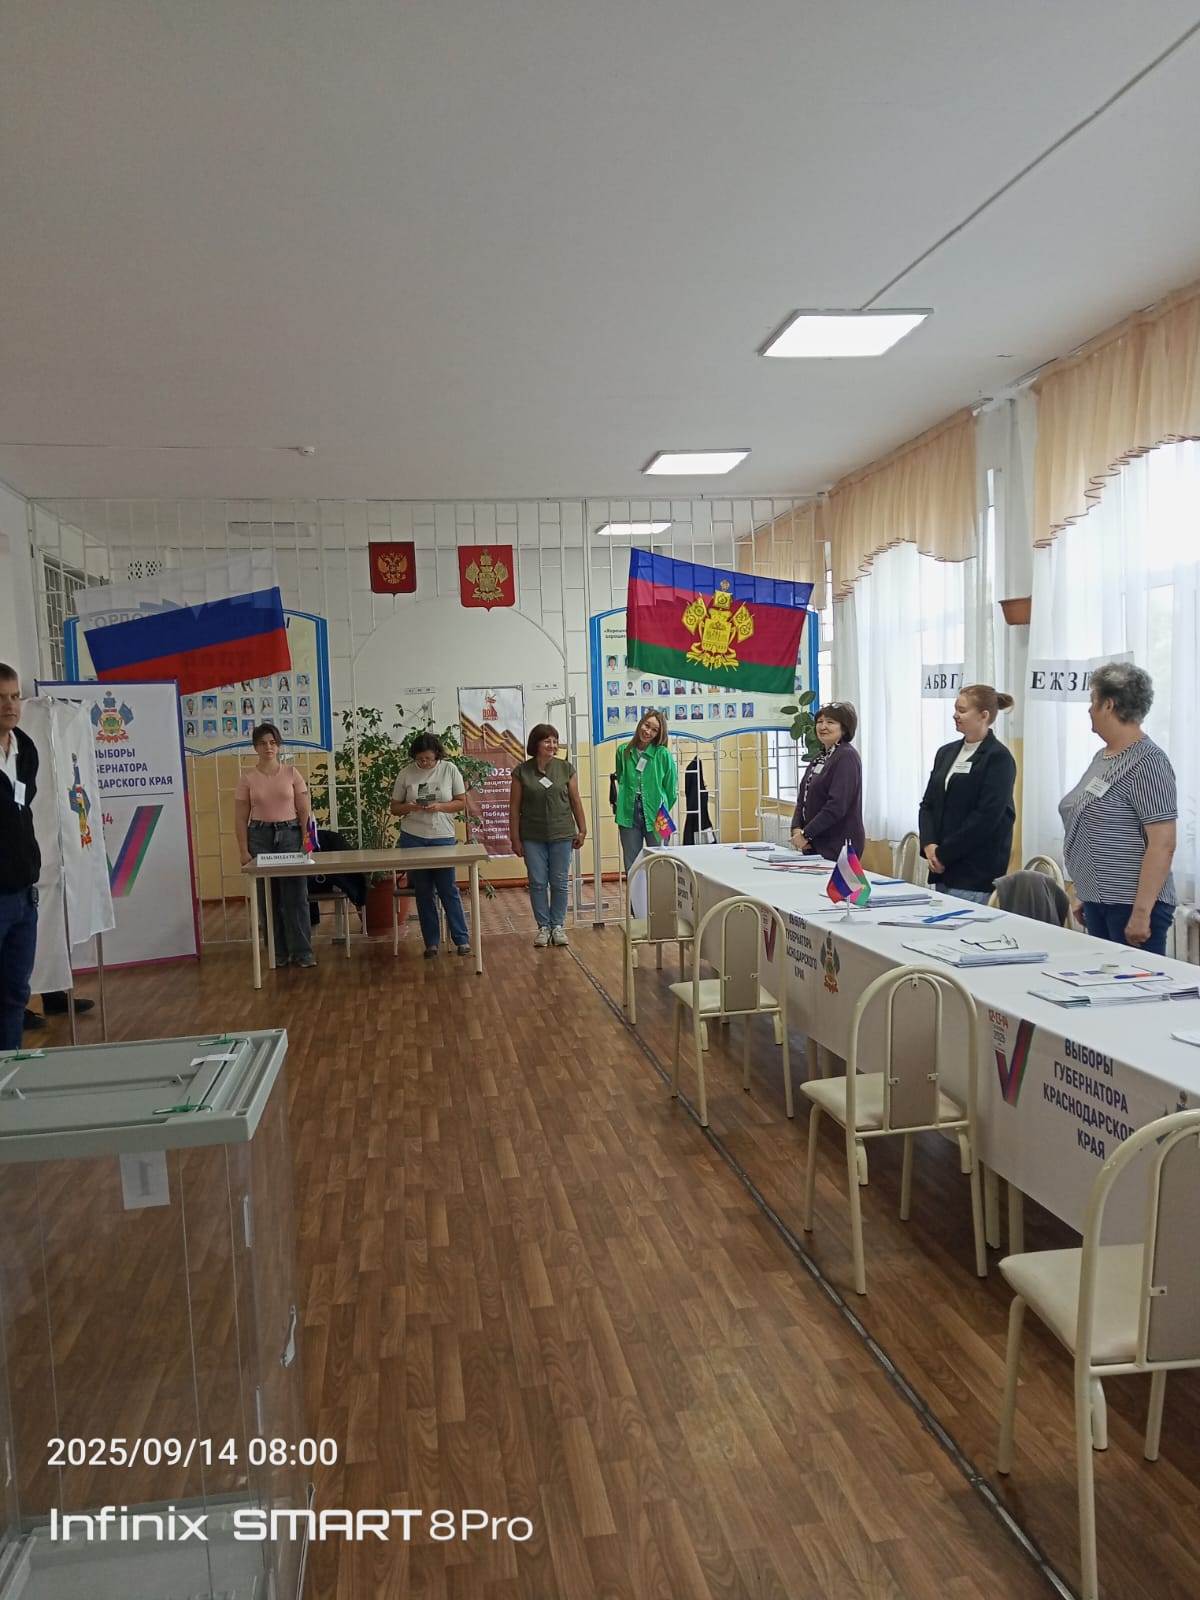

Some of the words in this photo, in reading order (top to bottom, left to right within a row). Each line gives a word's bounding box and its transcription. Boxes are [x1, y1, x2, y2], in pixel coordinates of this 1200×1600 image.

[149, 775, 173, 787] КРАЯ
[1064, 1037, 1114, 1077] ВЫБОРЫ
[1053, 1060, 1129, 1114] ГУБЕРНАТОРА
[1077, 1127, 1105, 1160] КРАЯ
